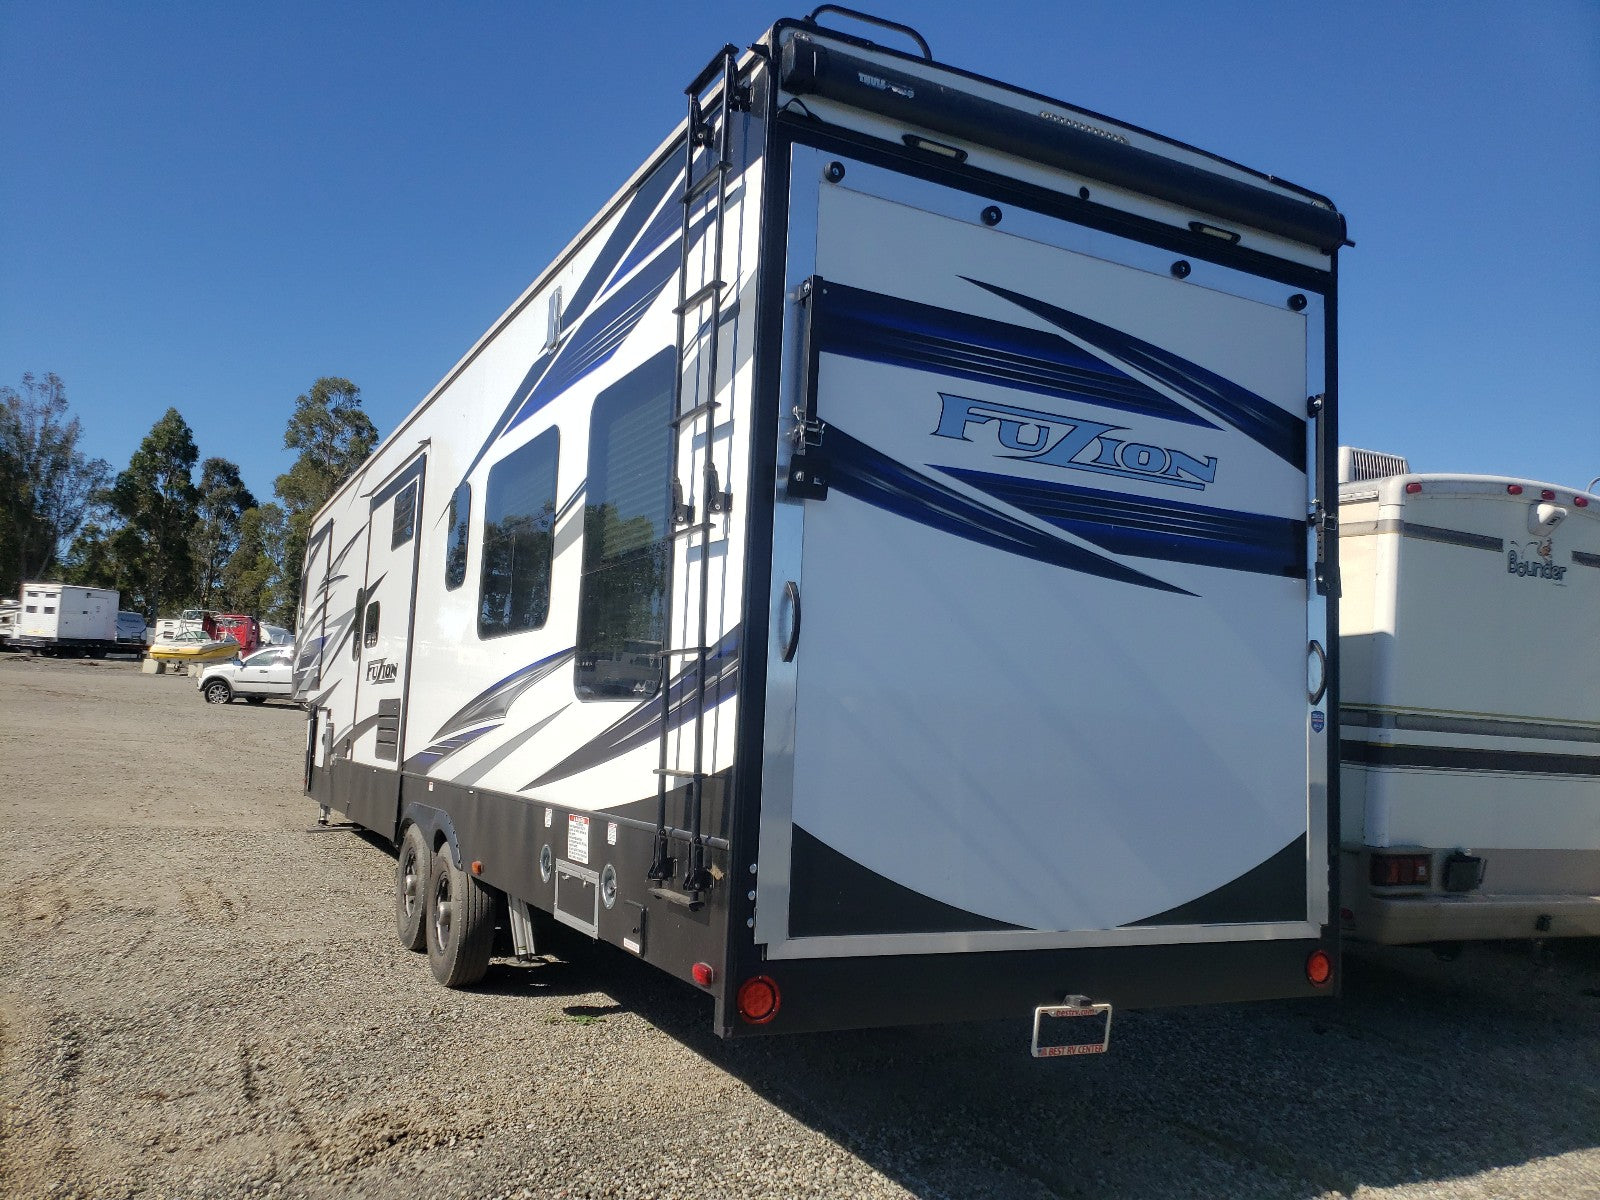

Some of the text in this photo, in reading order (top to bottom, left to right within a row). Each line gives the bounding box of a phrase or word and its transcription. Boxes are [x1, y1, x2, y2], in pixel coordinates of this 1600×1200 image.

[1507, 550, 1567, 581] Bounder
[1049, 1045, 1065, 1056] BEST
[1067, 1045, 1077, 1055] RV
[1078, 1044, 1104, 1054] CENTER
